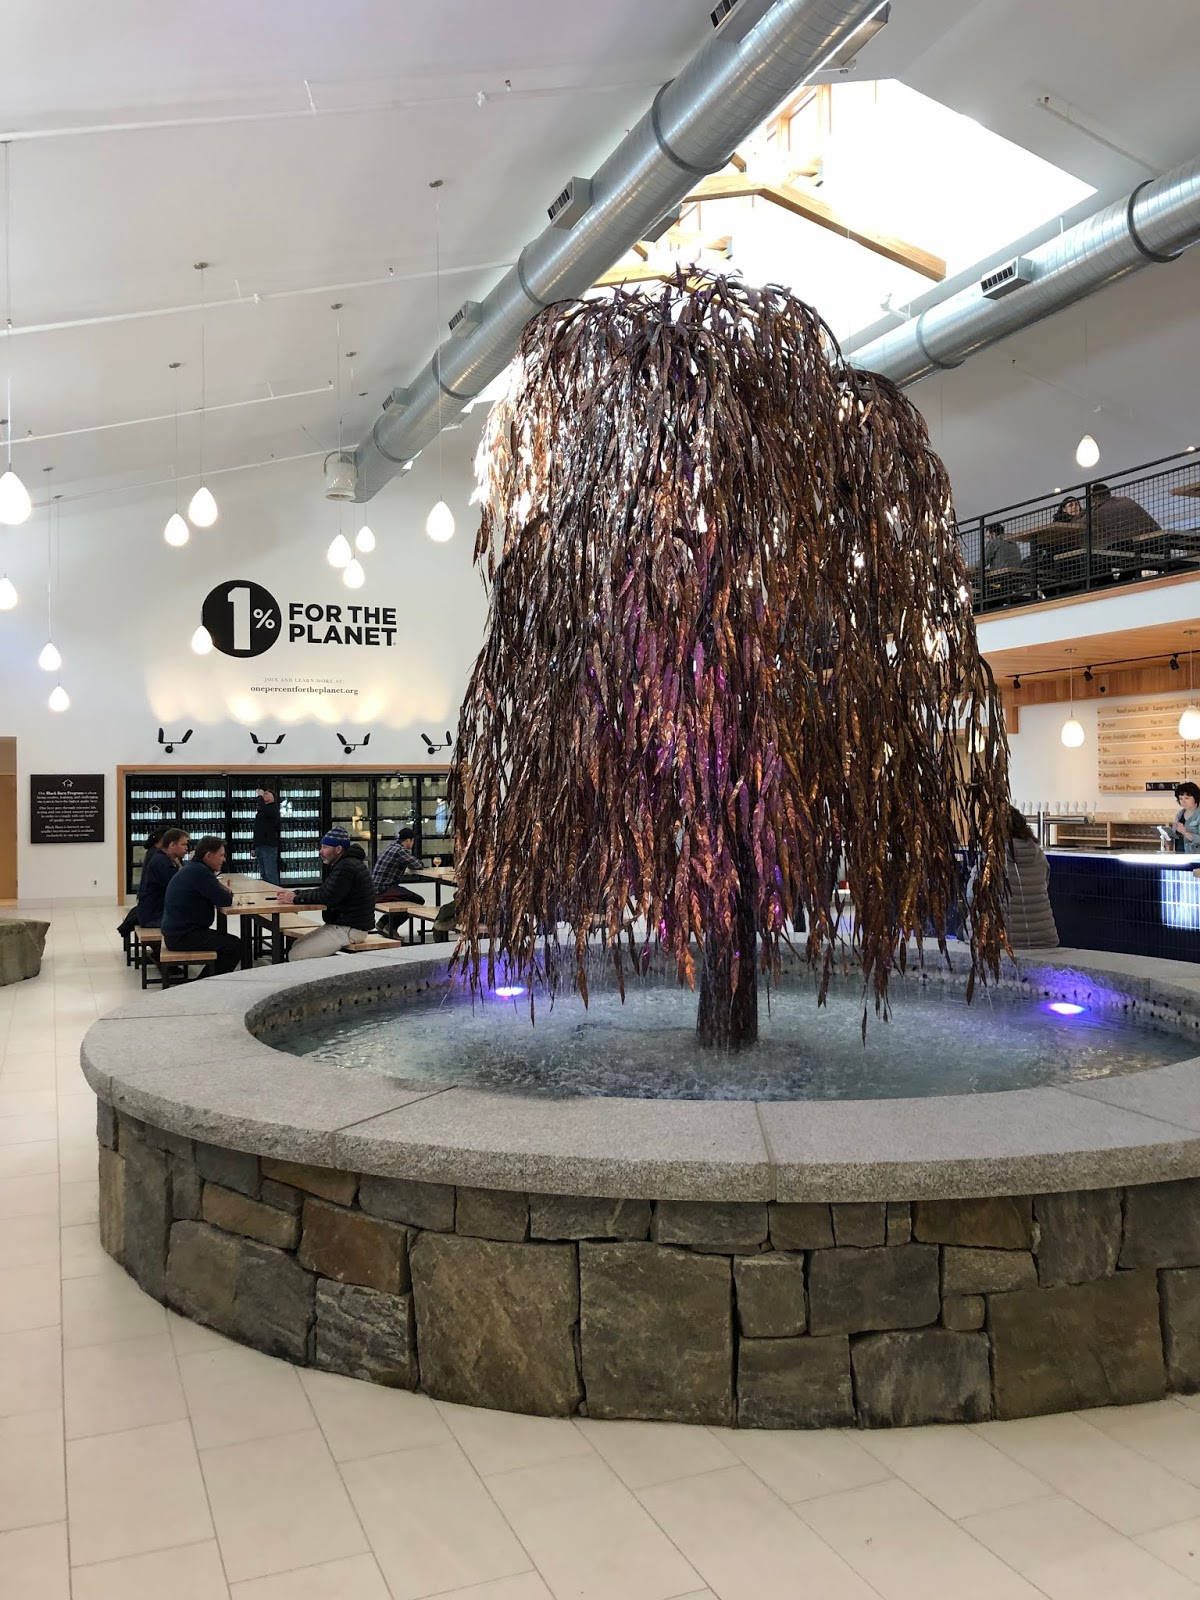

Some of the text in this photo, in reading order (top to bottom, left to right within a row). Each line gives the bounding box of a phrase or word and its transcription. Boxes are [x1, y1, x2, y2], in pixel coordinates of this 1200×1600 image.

[289, 602, 397, 626] FOR THE
[250, 684, 358, 695] onepercentfortheplanet.org
